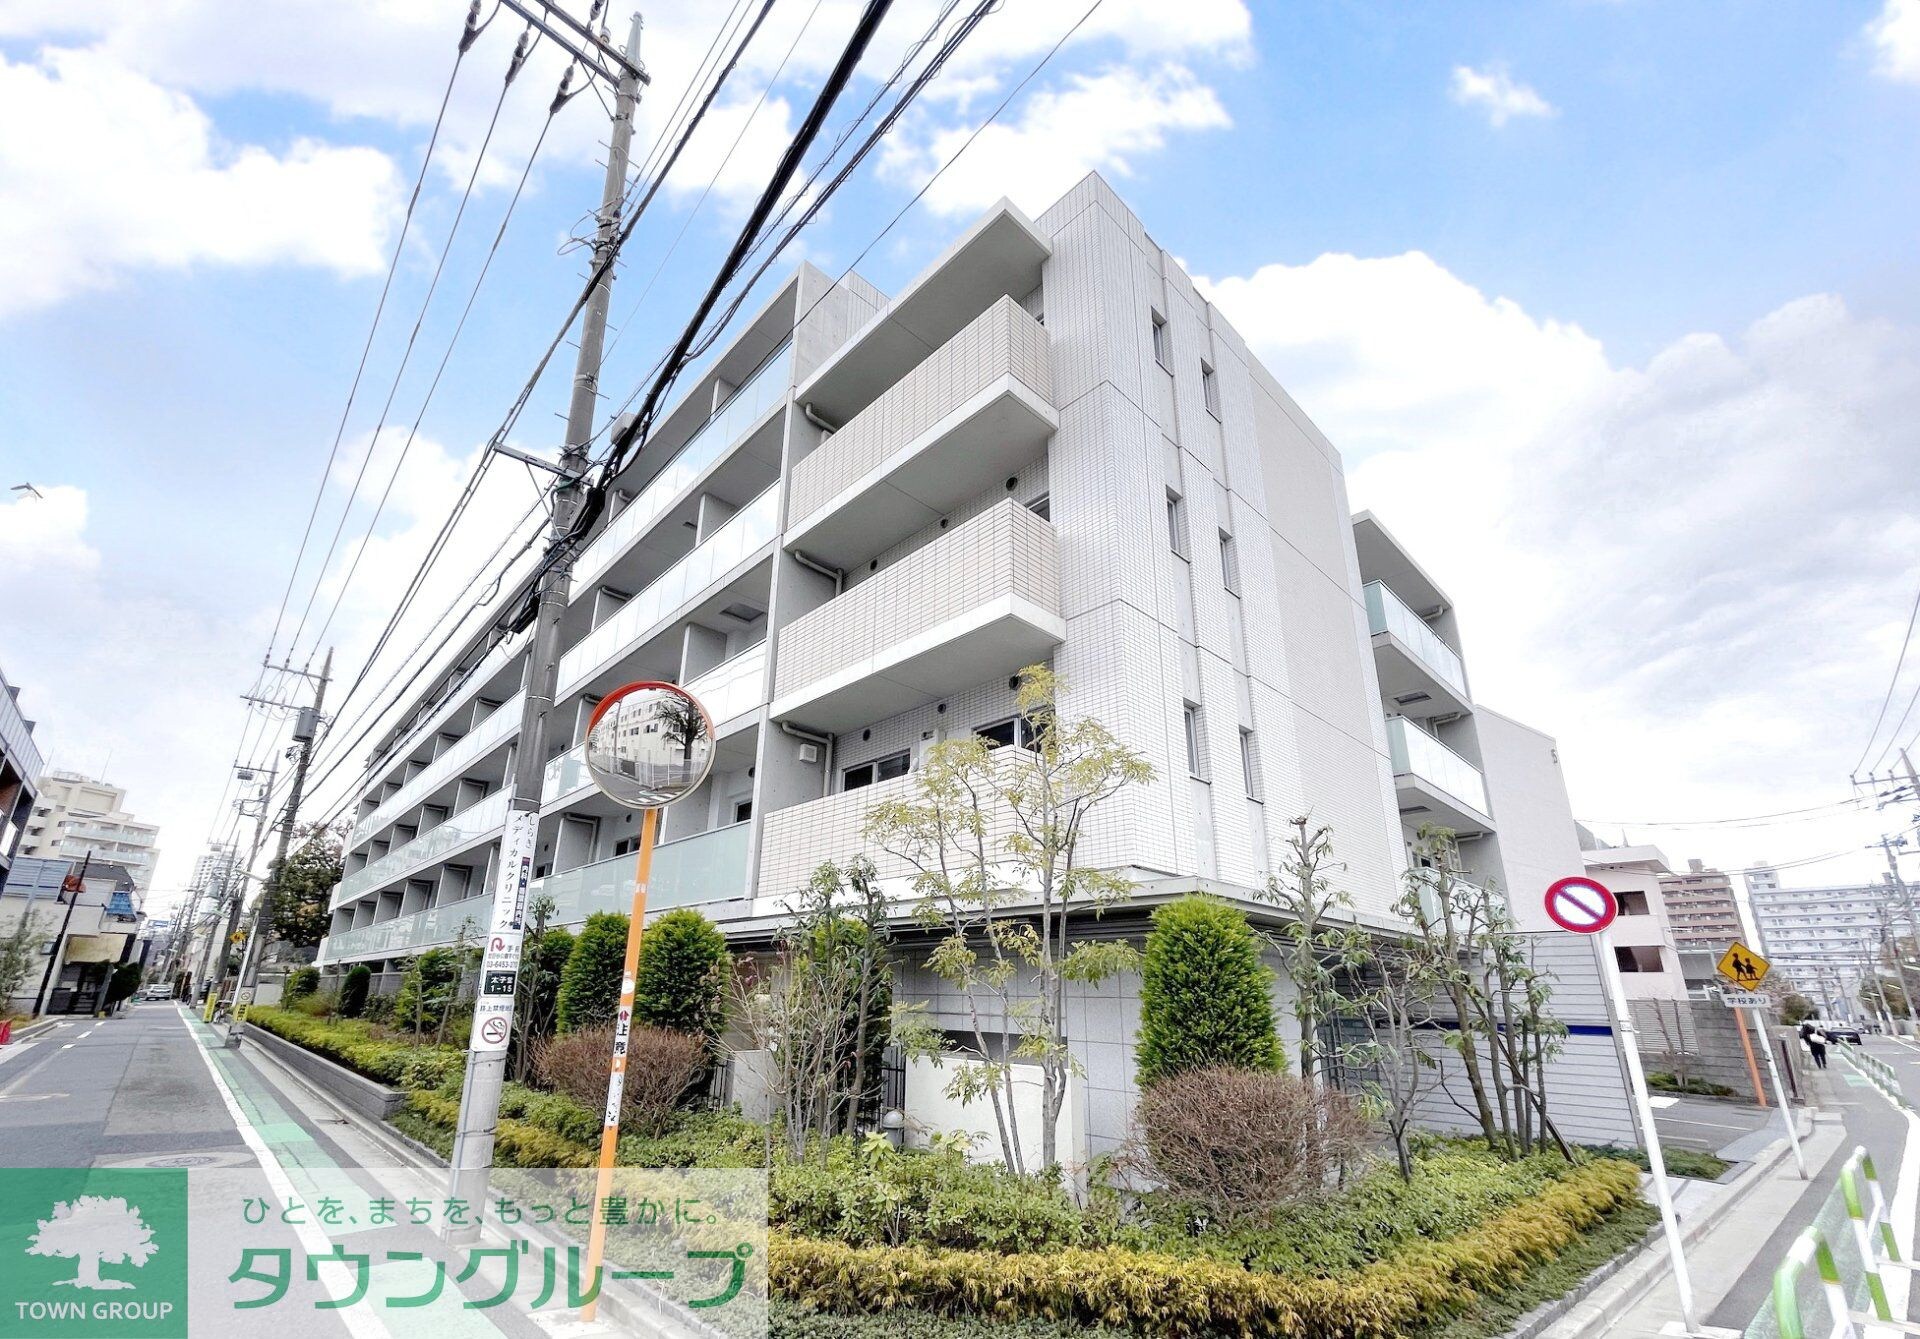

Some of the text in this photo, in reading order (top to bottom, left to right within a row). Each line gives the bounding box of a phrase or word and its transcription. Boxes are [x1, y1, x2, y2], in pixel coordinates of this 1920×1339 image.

[499, 815, 524, 929] メディカルクリニック
[1727, 997, 1767, 1005] 学校あり
